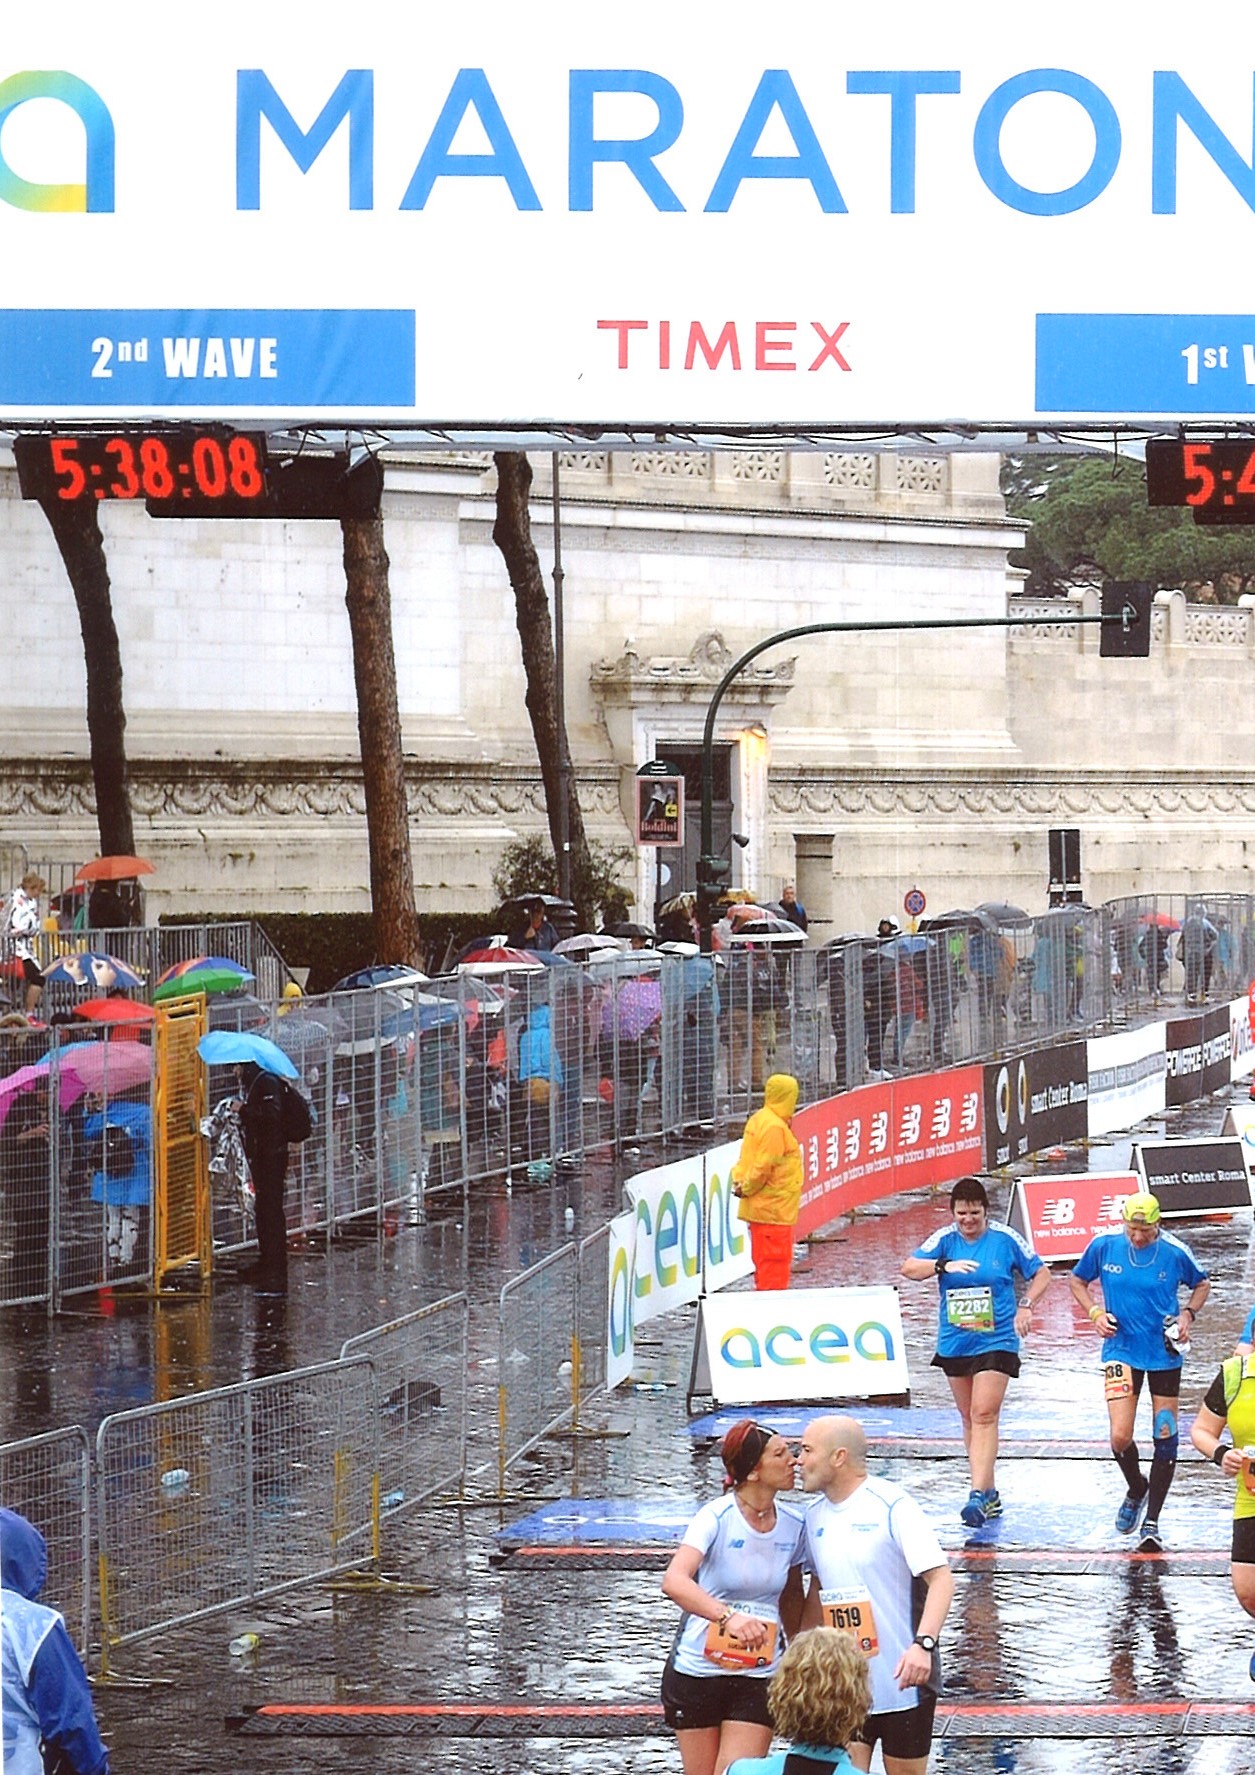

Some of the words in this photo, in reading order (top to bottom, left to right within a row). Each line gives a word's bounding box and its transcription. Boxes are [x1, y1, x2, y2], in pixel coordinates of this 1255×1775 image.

[91, 337, 148, 379] 2nd
[163, 338, 278, 378] WAVE
[596, 321, 852, 371] TIMEX
[1182, 344, 1228, 385] 1st
[53, 437, 263, 500] 5:38:08
[1150, 1171, 1179, 1186] smart
[1181, 1171, 1216, 1183] Center
[1219, 1170, 1247, 1183] Roma
[1034, 1229, 1051, 1238] new
[949, 1299, 990, 1316] F2282
[721, 1320, 895, 1368] acea
